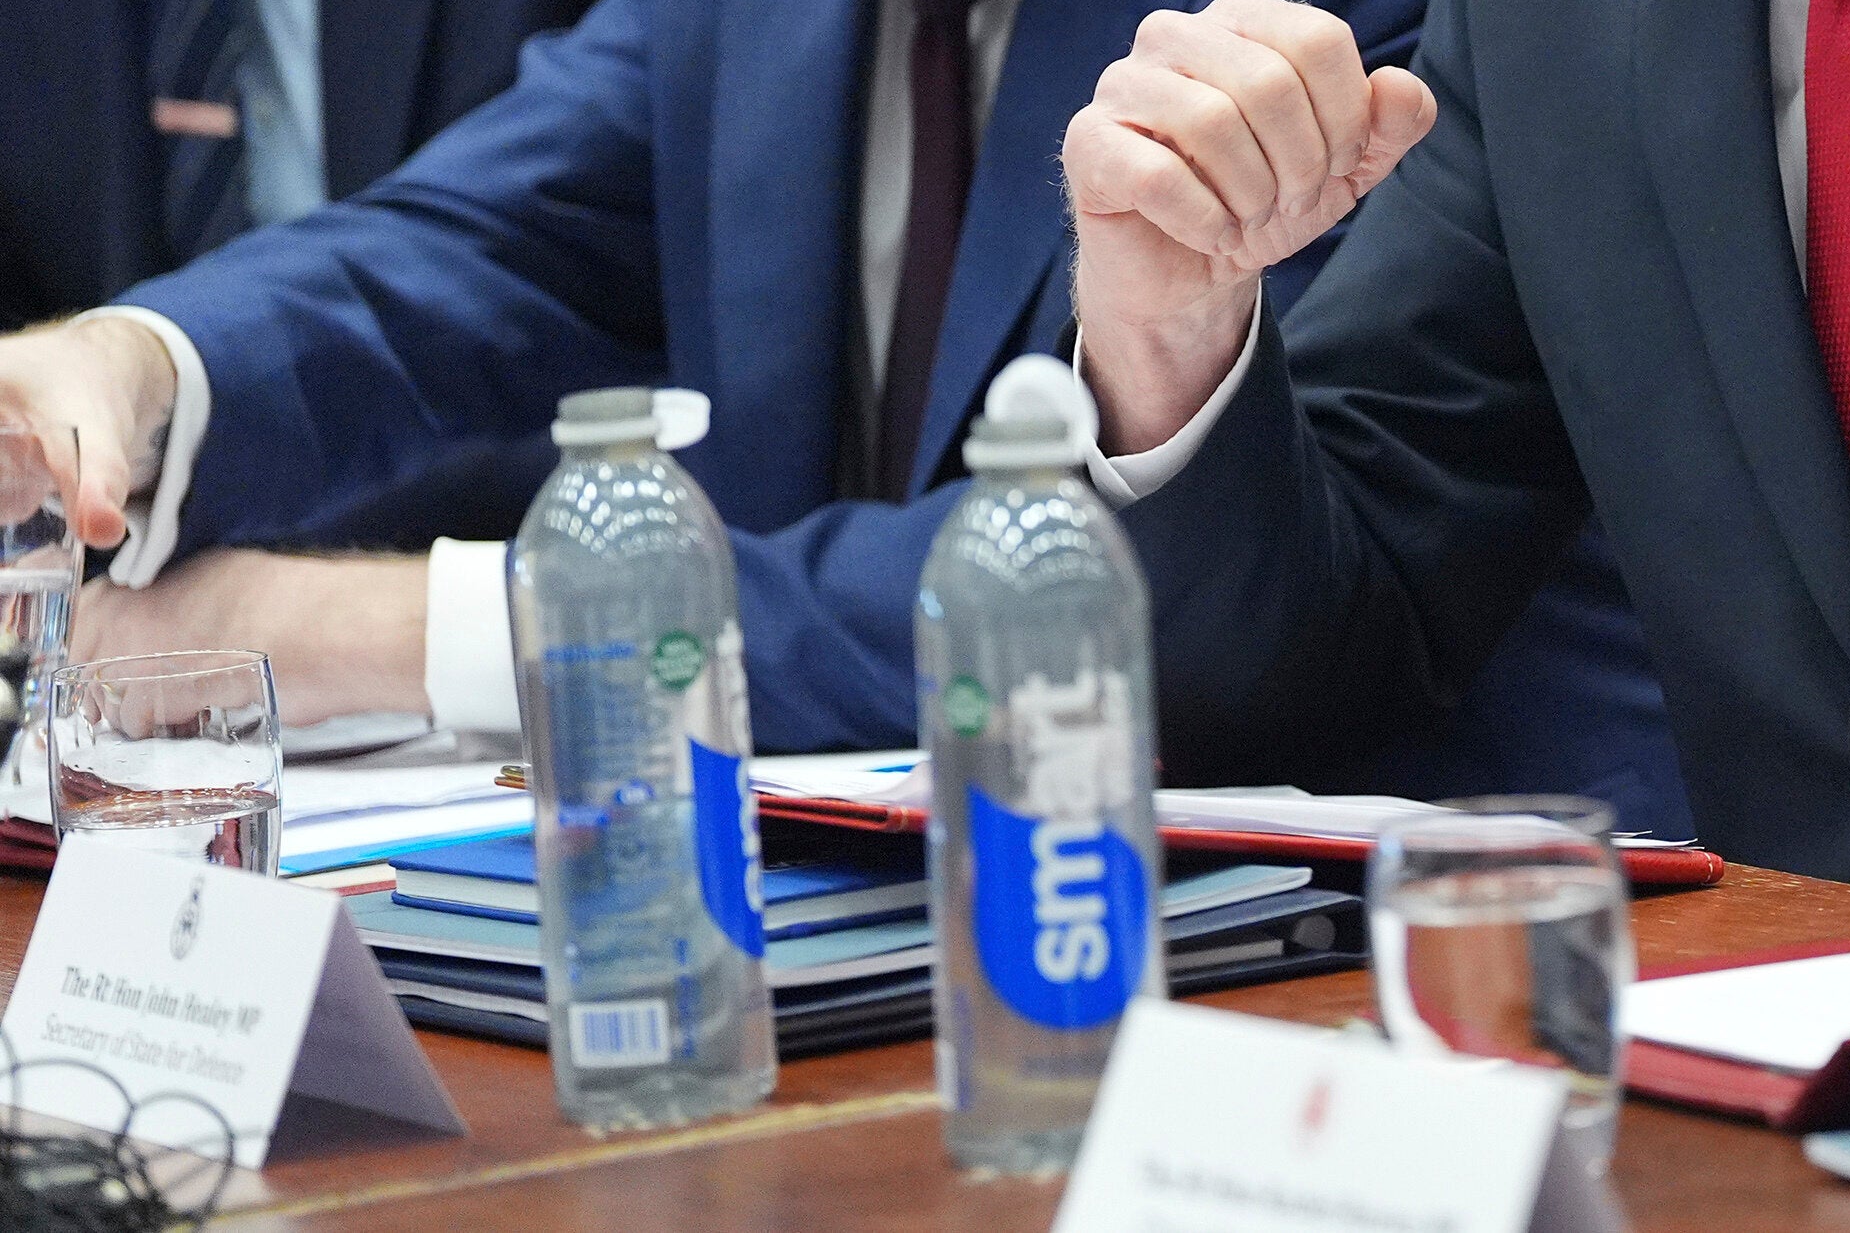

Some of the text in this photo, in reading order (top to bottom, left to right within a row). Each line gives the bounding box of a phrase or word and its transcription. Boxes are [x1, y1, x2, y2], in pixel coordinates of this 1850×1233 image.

[61, 965, 90, 997] The
[91, 972, 112, 1003] Rt
[112, 977, 142, 1010] Hon
[142, 984, 180, 1018] John
[41, 1012, 109, 1056] Secretary
[110, 1029, 130, 1057] of
[127, 1031, 163, 1066] State
